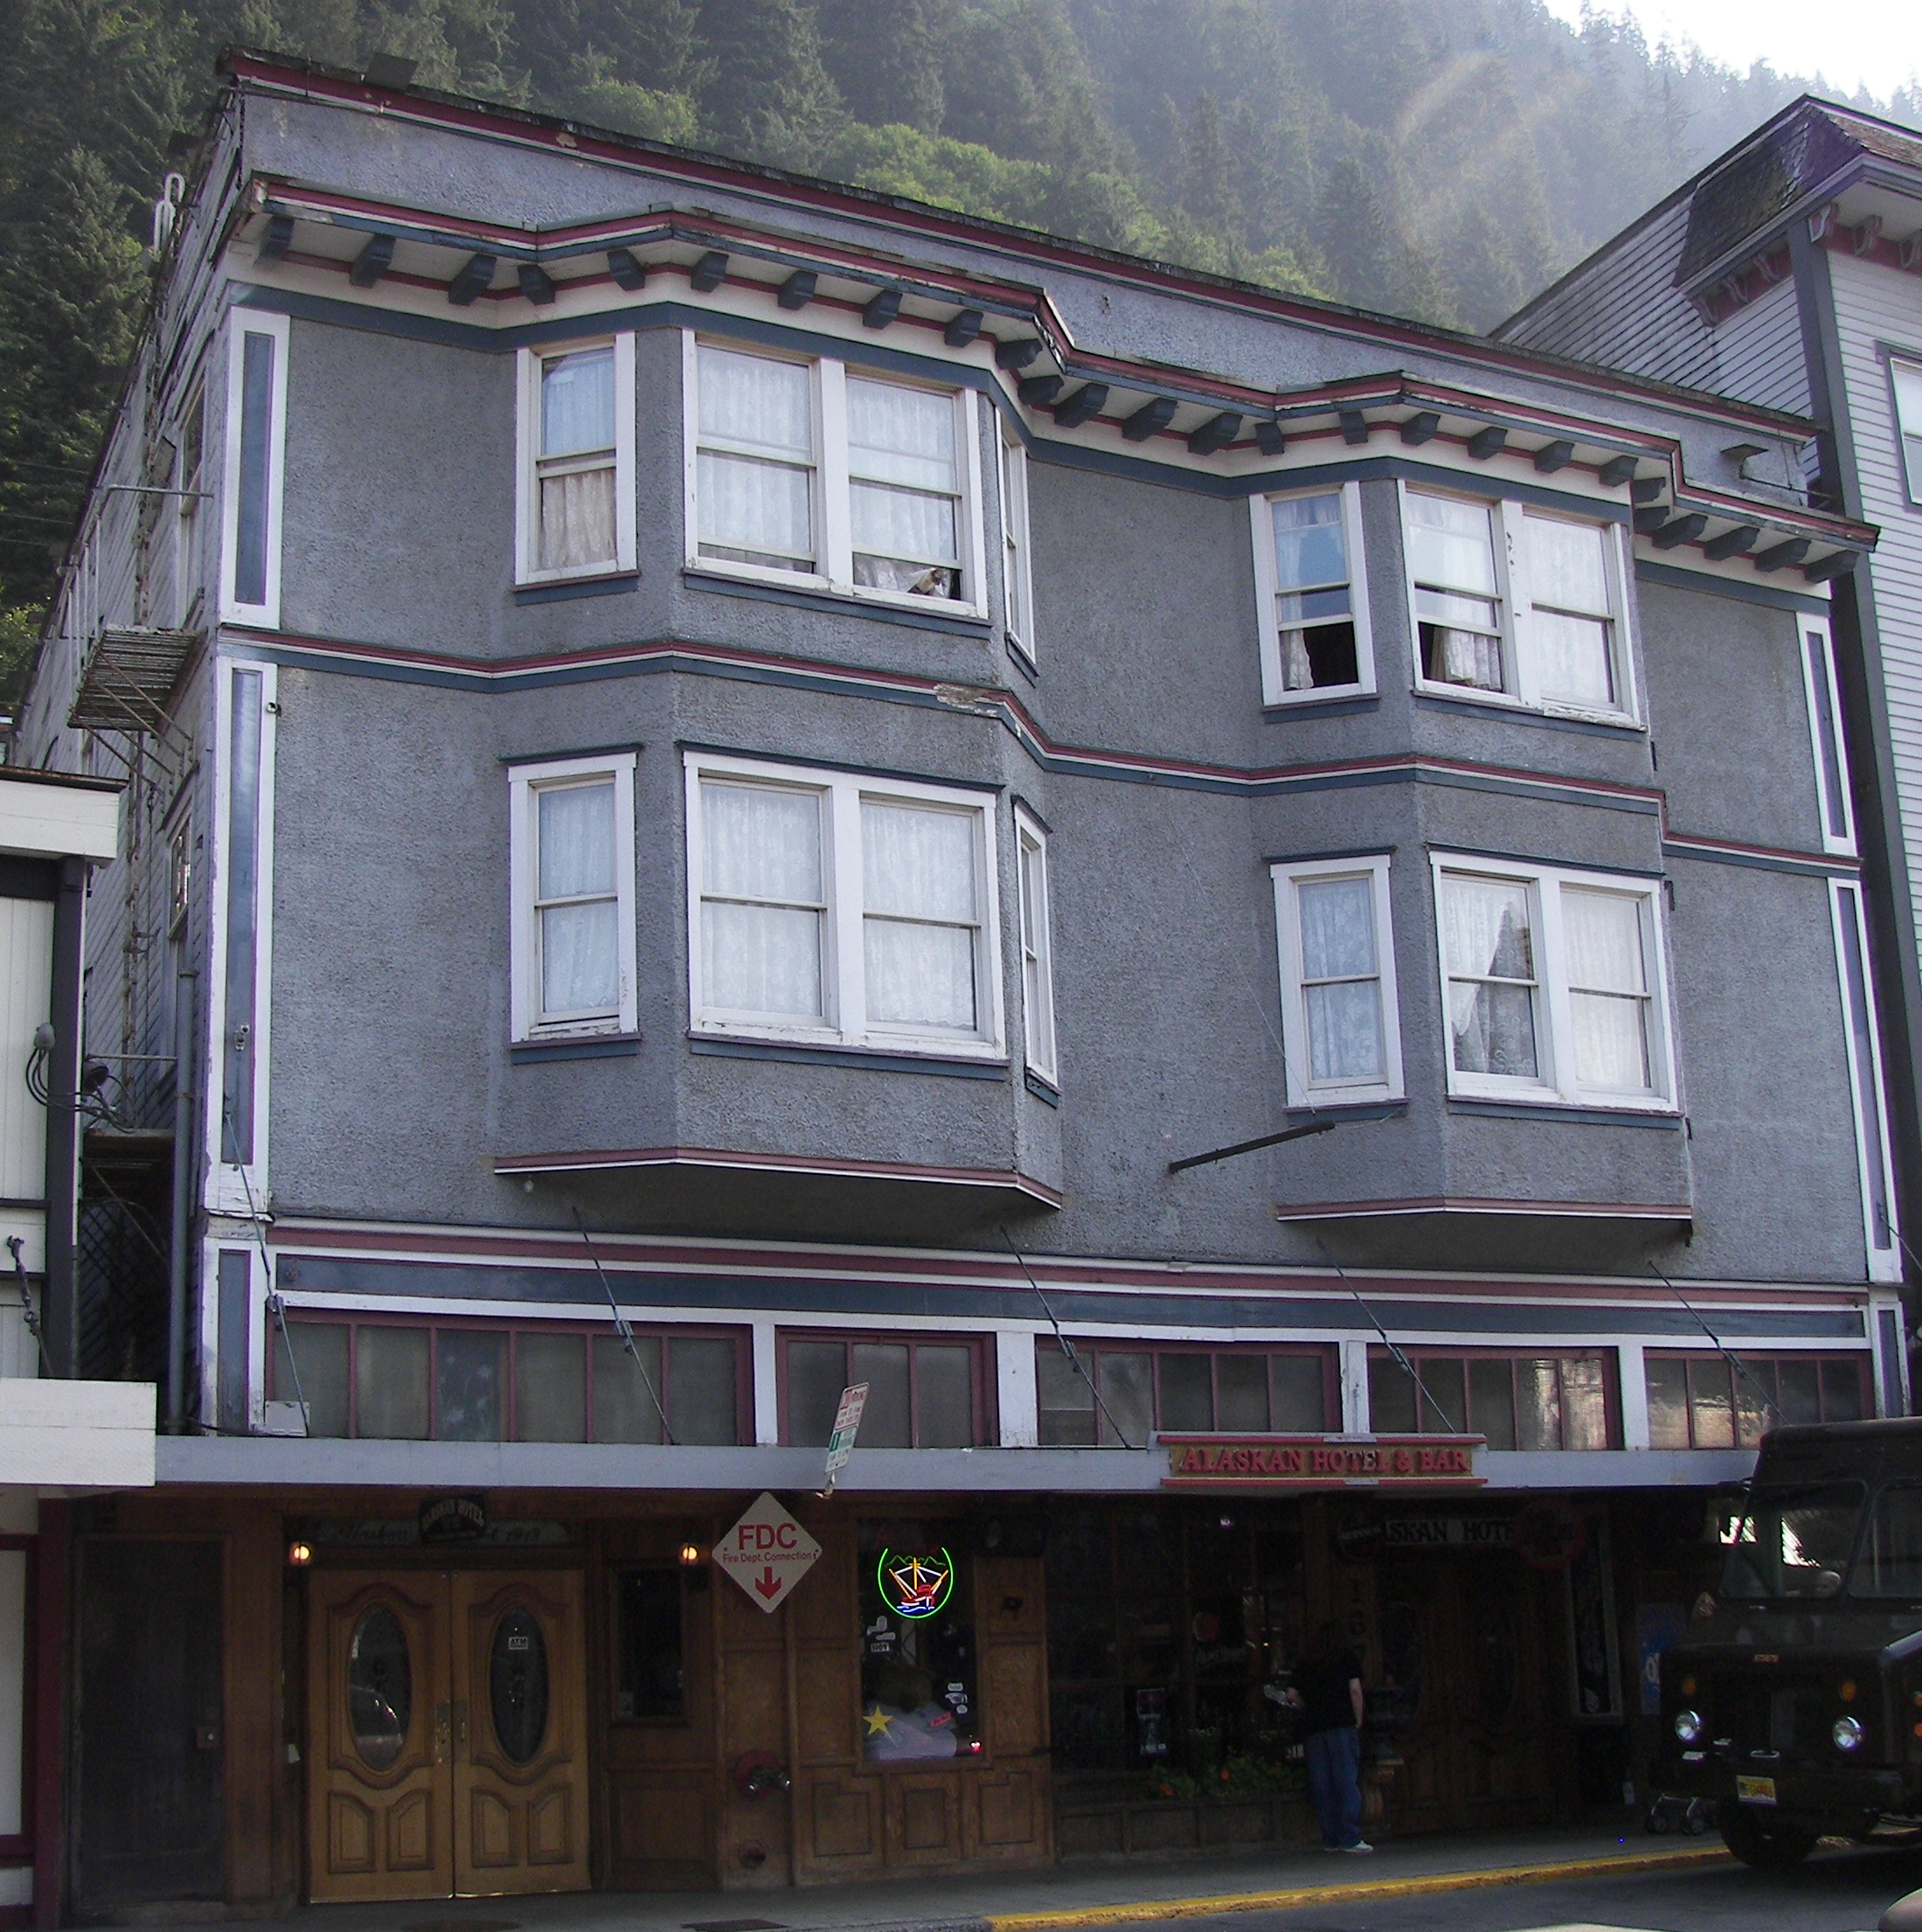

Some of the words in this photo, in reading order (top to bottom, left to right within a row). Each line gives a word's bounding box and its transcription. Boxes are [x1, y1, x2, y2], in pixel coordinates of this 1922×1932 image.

[1179, 1447, 1303, 1473] ALASKAN
[1309, 1449, 1390, 1473] HOTEL
[1393, 1449, 1412, 1473] &
[1416, 1449, 1469, 1473] BAR
[739, 1522, 798, 1550] FDC
[1386, 1519, 1447, 1542] SKAN
[1462, 1519, 1513, 1542] HOTE
[723, 1553, 739, 1564] Fire
[740, 1553, 763, 1563] Dept.
[764, 1552, 812, 1562] Connection
